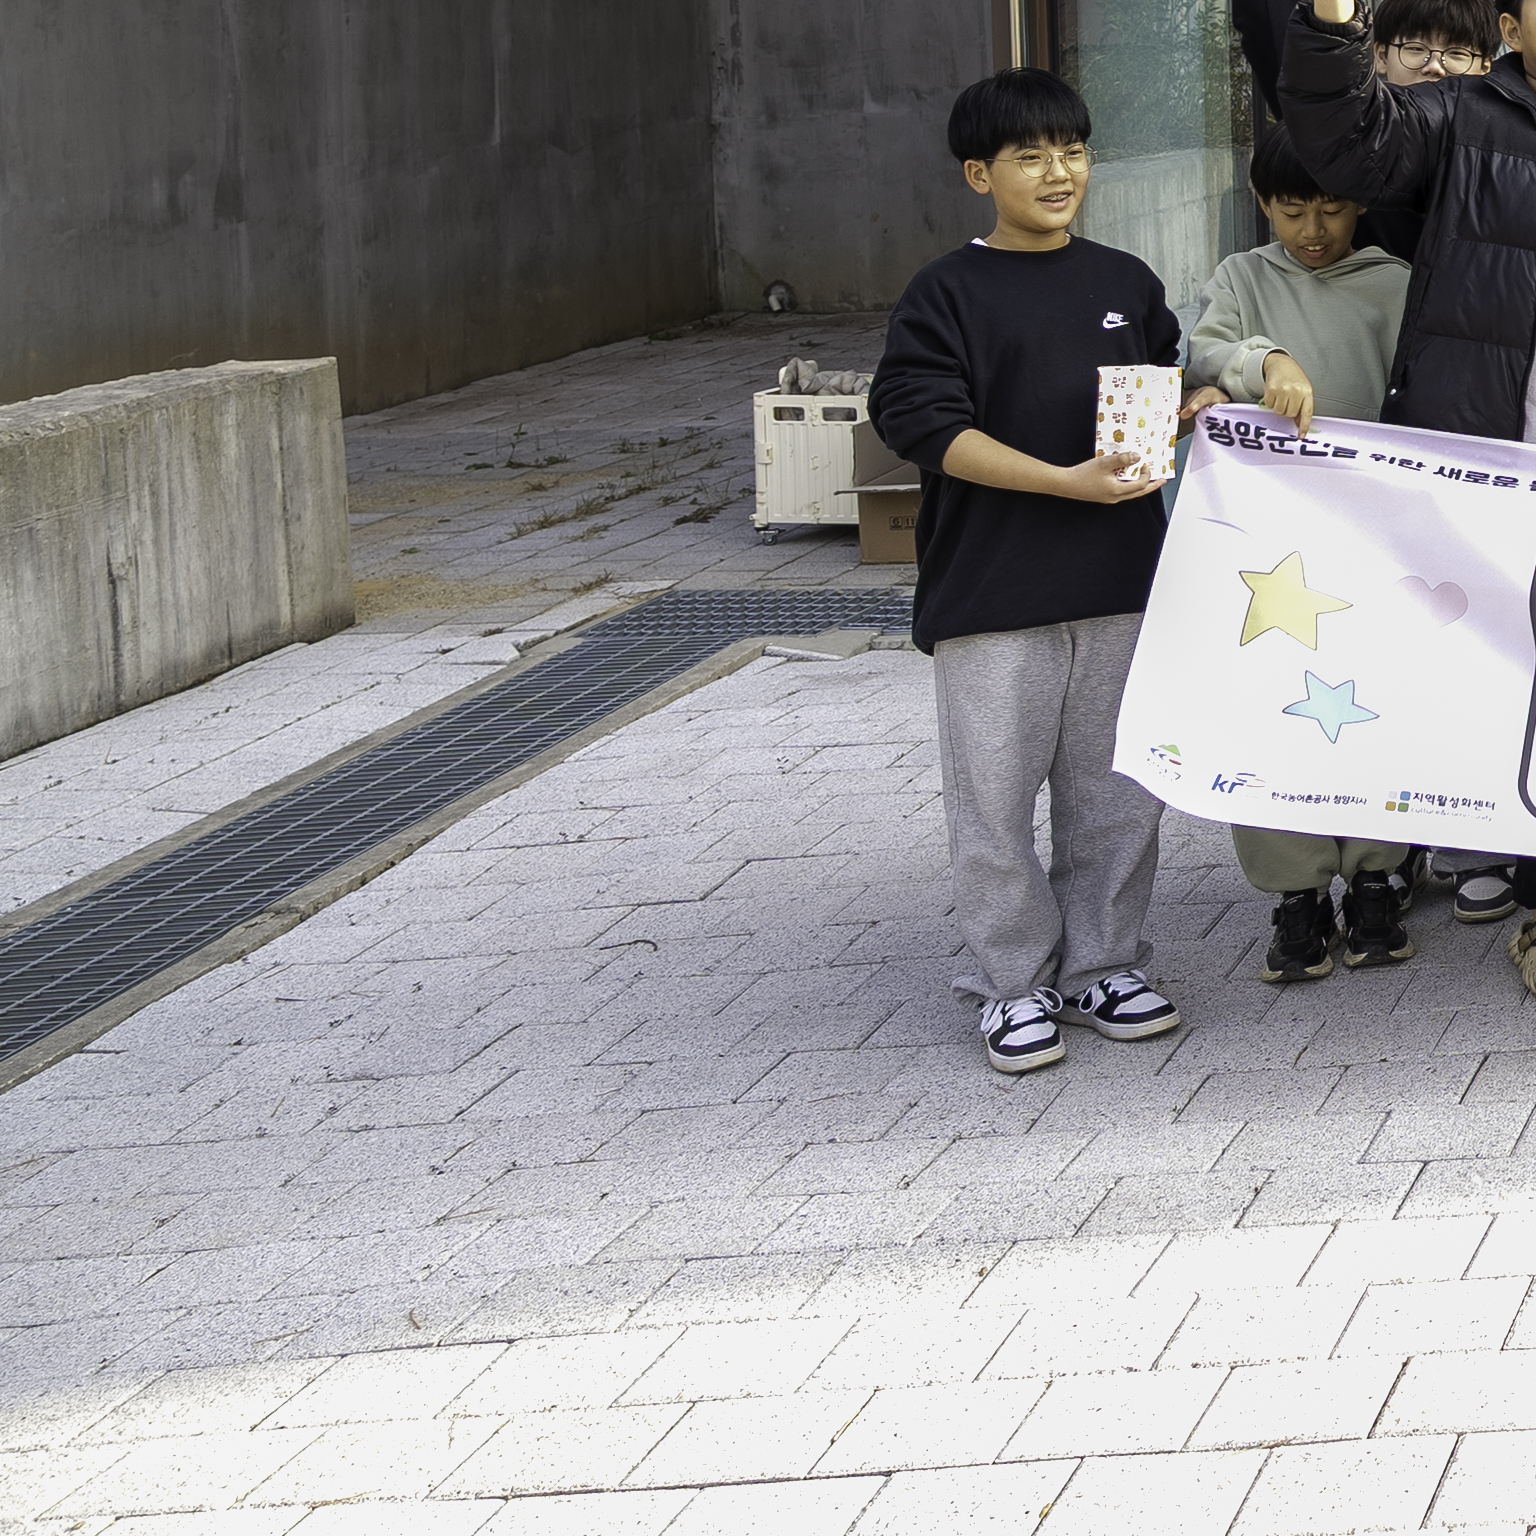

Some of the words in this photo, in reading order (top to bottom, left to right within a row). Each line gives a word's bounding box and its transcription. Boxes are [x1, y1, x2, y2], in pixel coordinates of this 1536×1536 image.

[1106, 312, 1124, 323] NIKE
[1433, 466, 1520, 488] 새로운
[1271, 791, 1330, 804] 한국농어촌공사
[1333, 794, 1367, 805] 청양지사
[1413, 792, 1496, 811] 지역활성화센터
